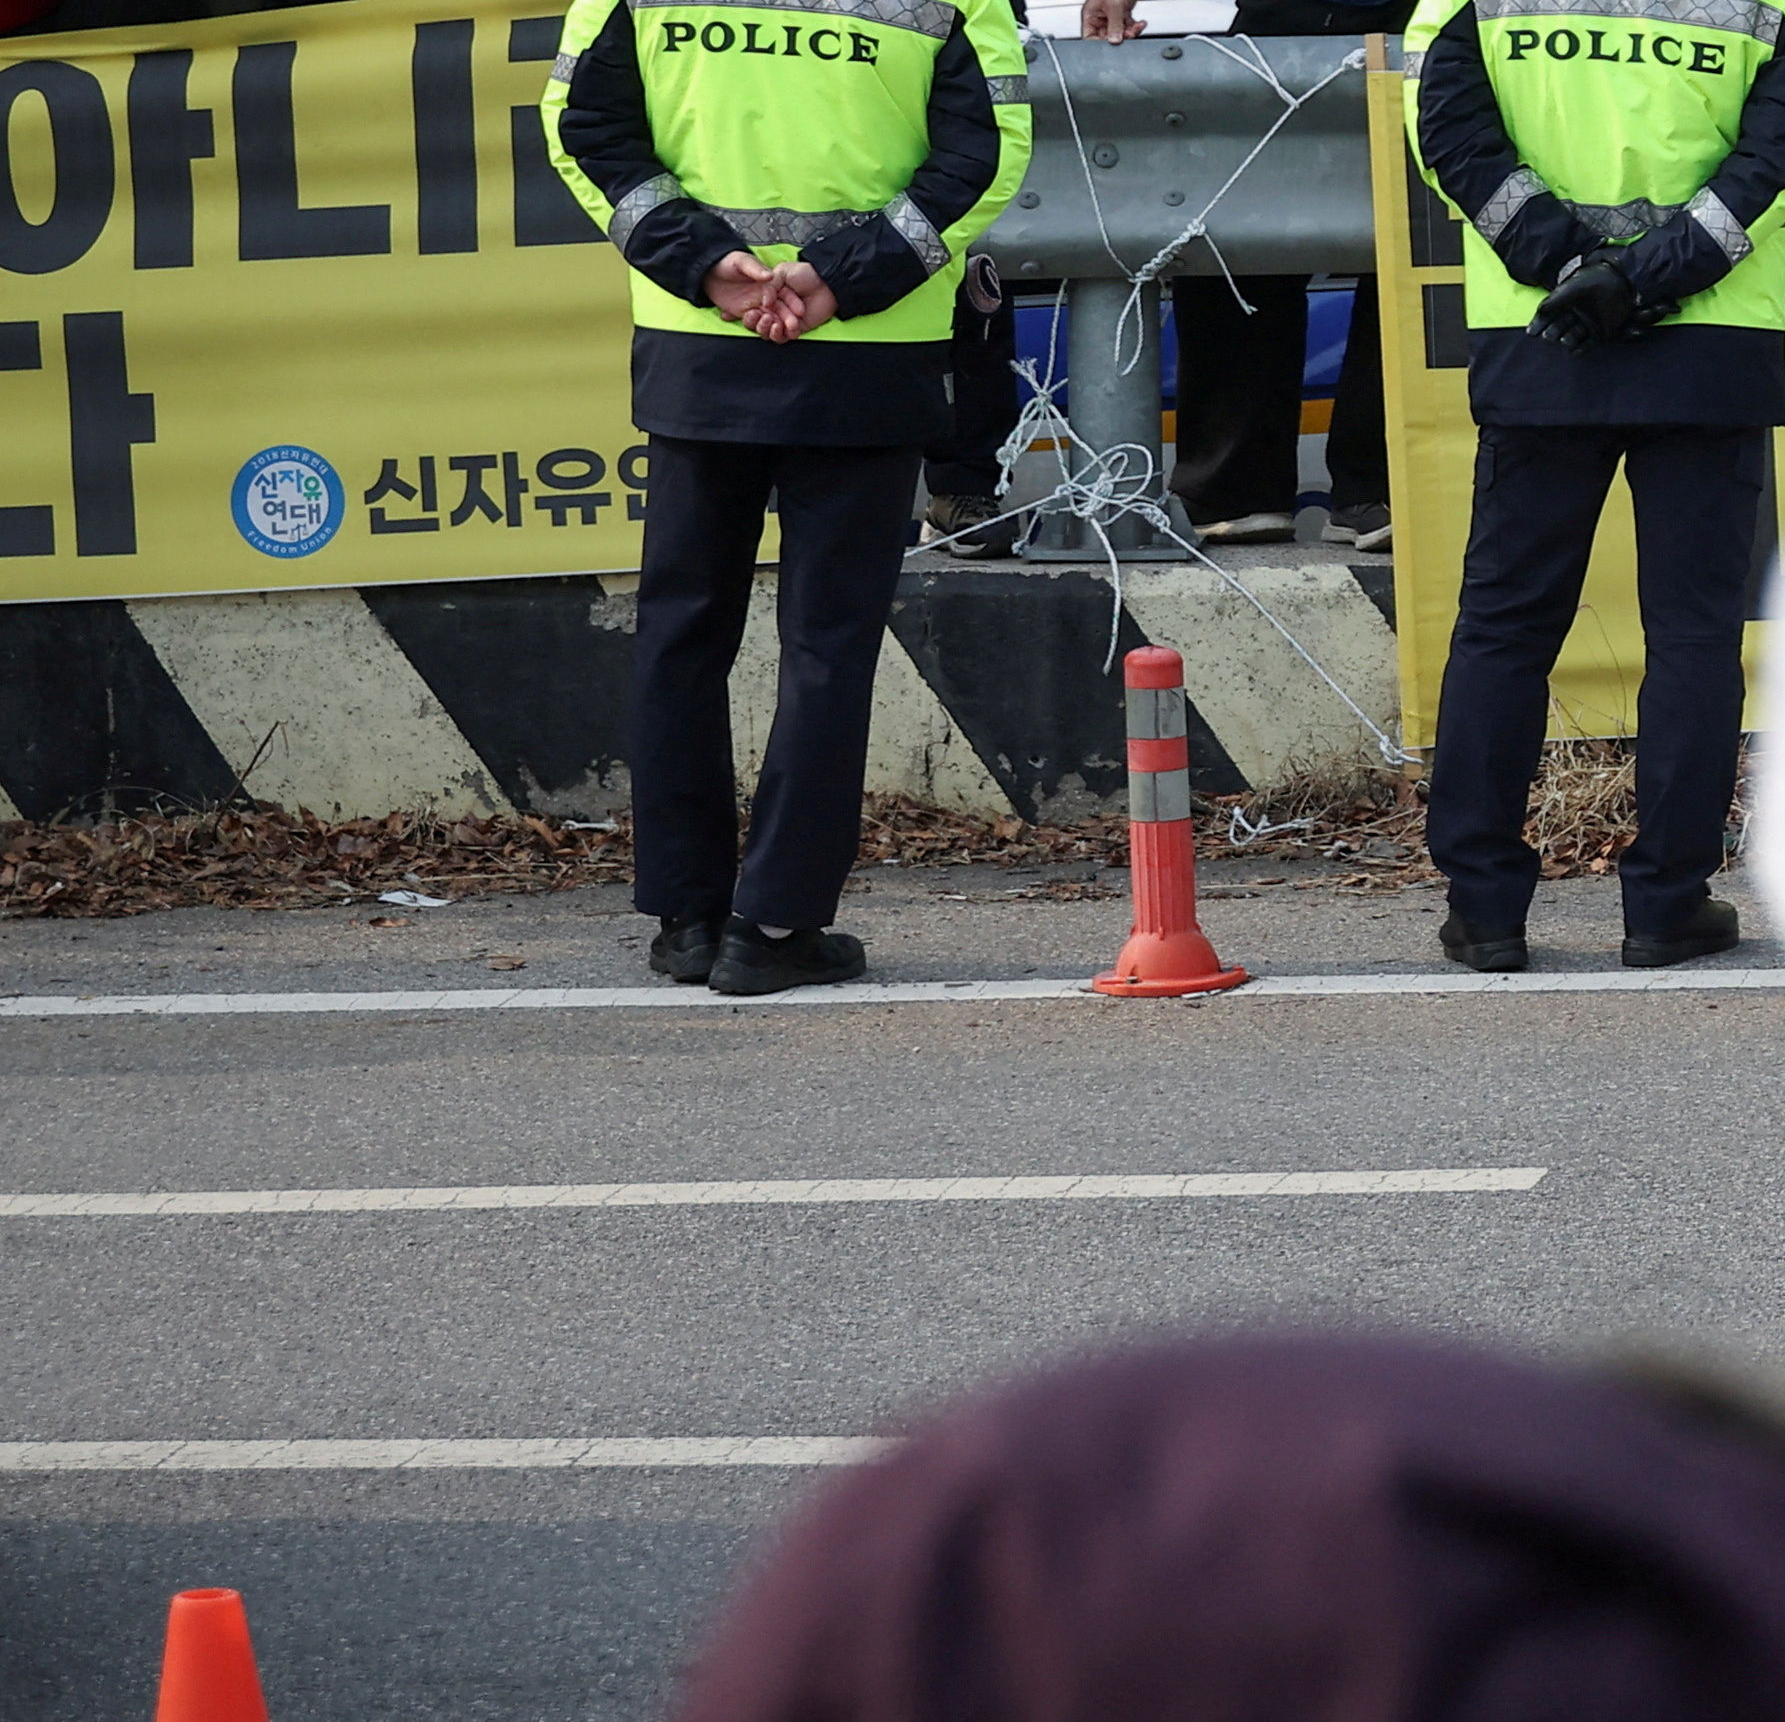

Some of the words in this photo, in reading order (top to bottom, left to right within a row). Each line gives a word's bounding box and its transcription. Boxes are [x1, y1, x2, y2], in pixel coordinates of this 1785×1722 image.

[661, 21, 881, 67] POLICE
[1505, 29, 1727, 76] POLICE
[364, 447, 649, 535] 신자유
